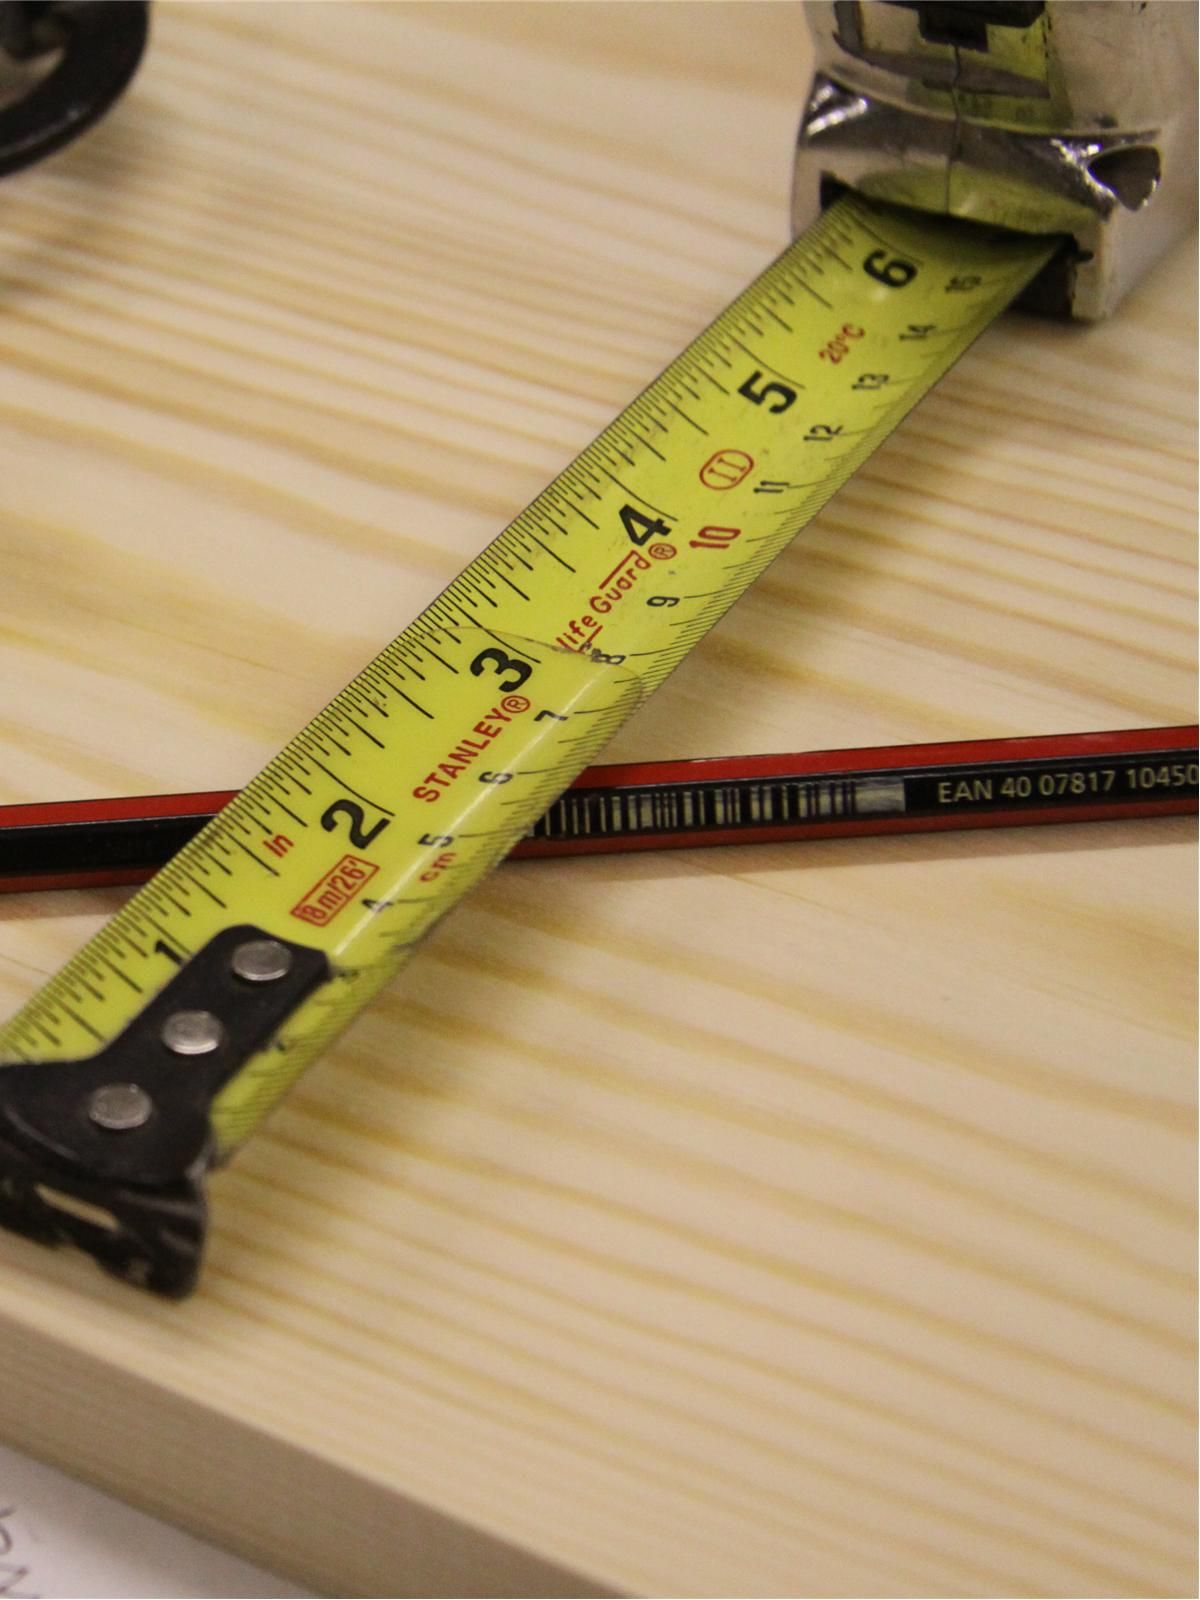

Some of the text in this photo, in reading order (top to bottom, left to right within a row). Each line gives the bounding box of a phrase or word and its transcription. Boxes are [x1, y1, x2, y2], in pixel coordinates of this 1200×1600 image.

[863, 250, 918, 288] 6
[945, 275, 982, 293] 15
[899, 324, 936, 340] 14
[818, 322, 866, 365] 20°C
[851, 373, 889, 391] 13
[737, 370, 798, 415] 5
[803, 424, 844, 441] 12
[753, 480, 790, 494] 11
[619, 504, 672, 546] 4
[689, 526, 742, 549] 10
[646, 595, 681, 608] 9
[470, 648, 533, 693] 3
[533, 710, 569, 722] 7
[478, 771, 513, 785] 6
[938, 779, 993, 803] EAN
[1001, 776, 1032, 798] 40
[1038, 770, 1116, 796] 07817
[320, 798, 391, 850] 2
[418, 833, 455, 848] 5
[419, 852, 457, 882] cm
[362, 899, 394, 913] 4
[154, 939, 184, 966] 1
